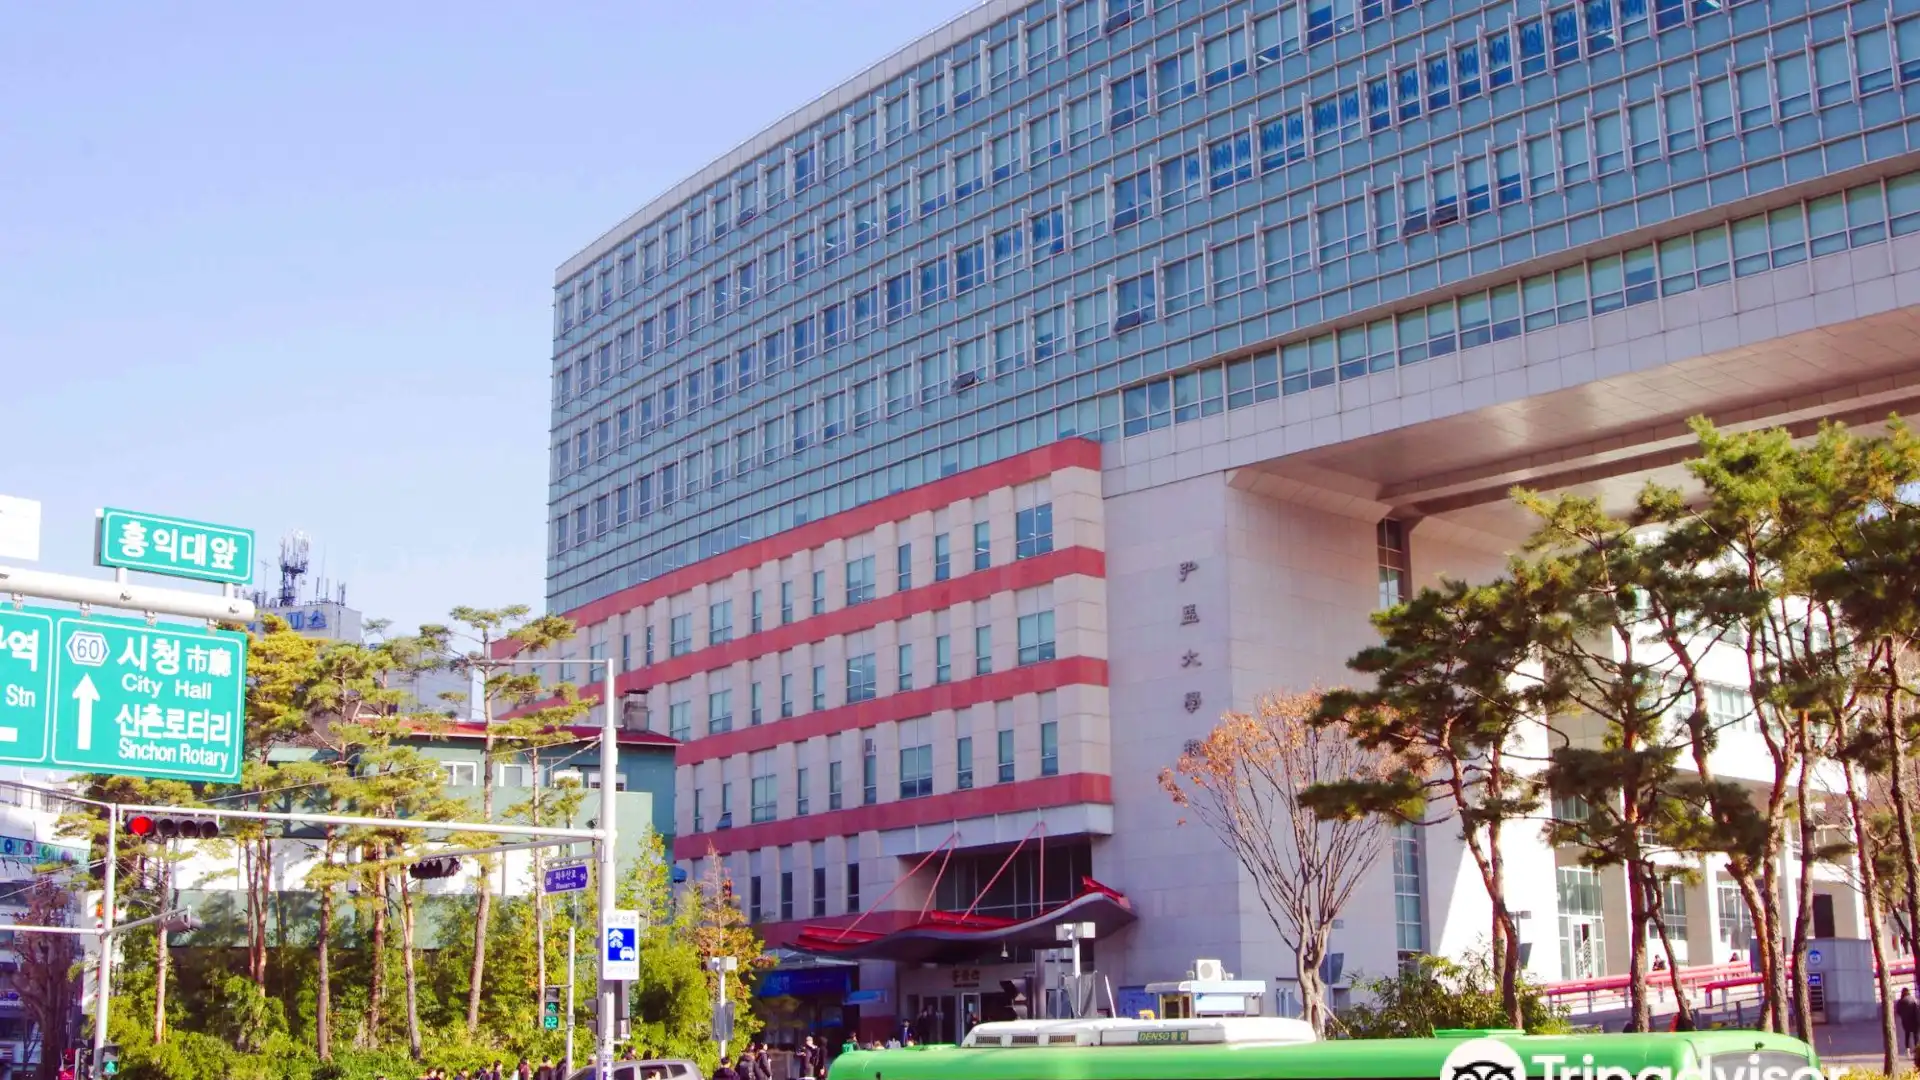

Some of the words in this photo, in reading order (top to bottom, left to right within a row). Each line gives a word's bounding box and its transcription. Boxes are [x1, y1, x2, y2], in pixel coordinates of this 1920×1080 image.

[118, 520, 238, 570] 홍익대앞
[0, 624, 39, 672] 역
[77, 638, 99, 660] 60
[117, 635, 180, 675] 시청
[5, 683, 36, 708] Stn
[121, 673, 163, 699] City
[175, 679, 212, 700] Hall
[115, 703, 232, 747] 신촌로터리
[118, 737, 177, 763] Sinchon
[179, 743, 229, 773] Rotary
[545, 1016, 558, 1028] 22
